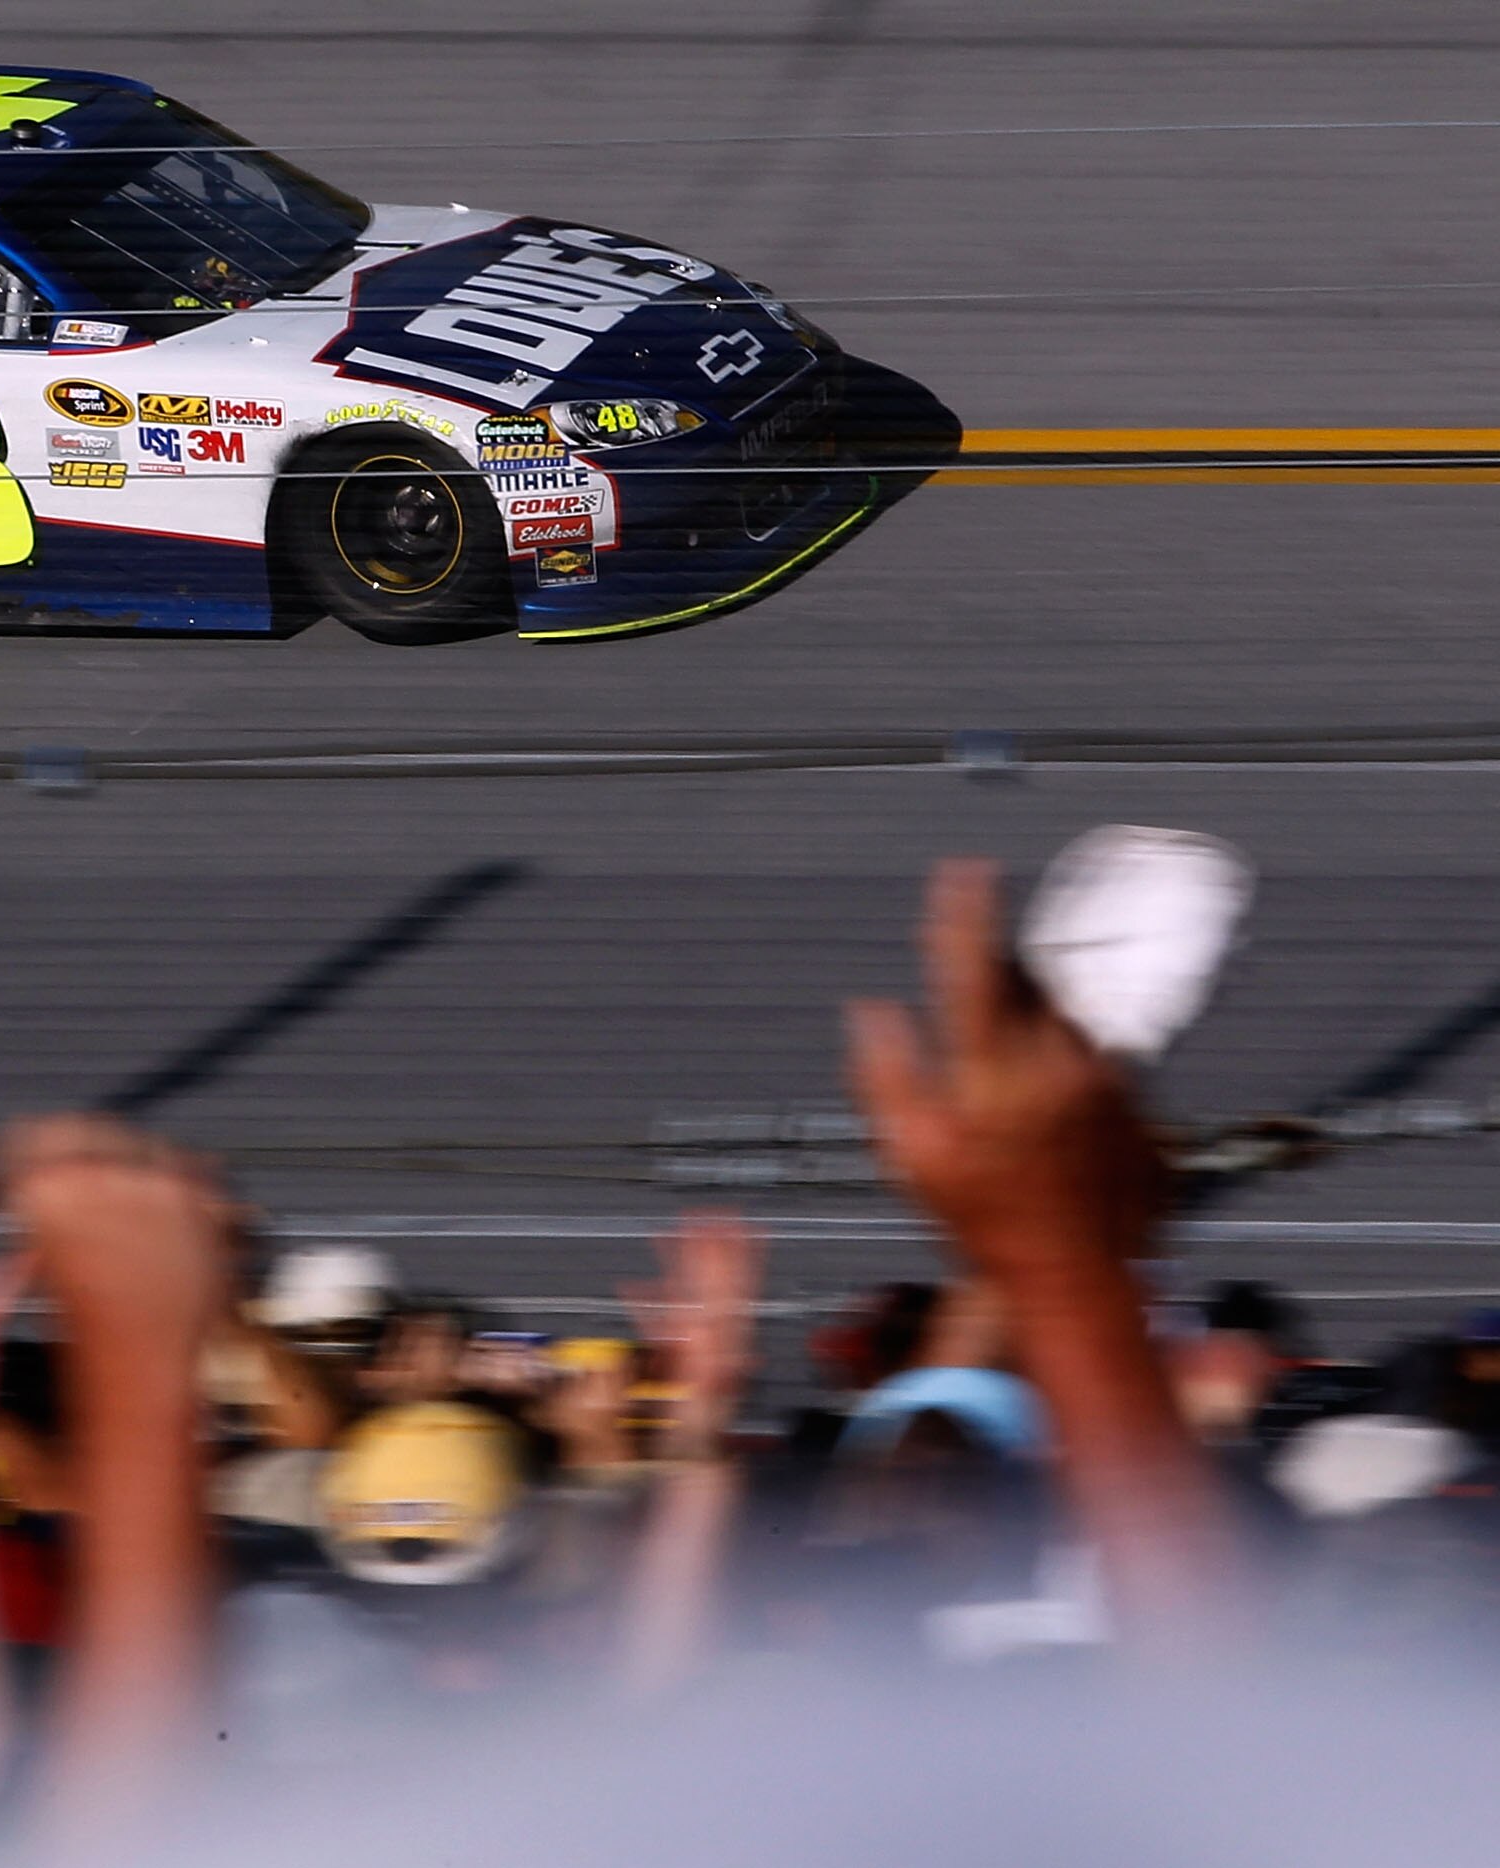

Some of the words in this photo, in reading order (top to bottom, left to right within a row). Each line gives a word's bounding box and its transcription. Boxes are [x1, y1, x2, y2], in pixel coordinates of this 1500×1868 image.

[344, 227, 716, 408] LOWE'S
[74, 400, 106, 412] Sprint
[215, 400, 282, 427] Holley
[597, 404, 638, 432] 48
[138, 427, 182, 462] USG
[187, 429, 245, 463] 3M
[480, 444, 566, 462] MOOG
[49, 461, 128, 488] JEGS
[496, 467, 590, 492] MAHLE
[510, 496, 581, 515] COMP
[518, 522, 587, 543] Edelbrock
